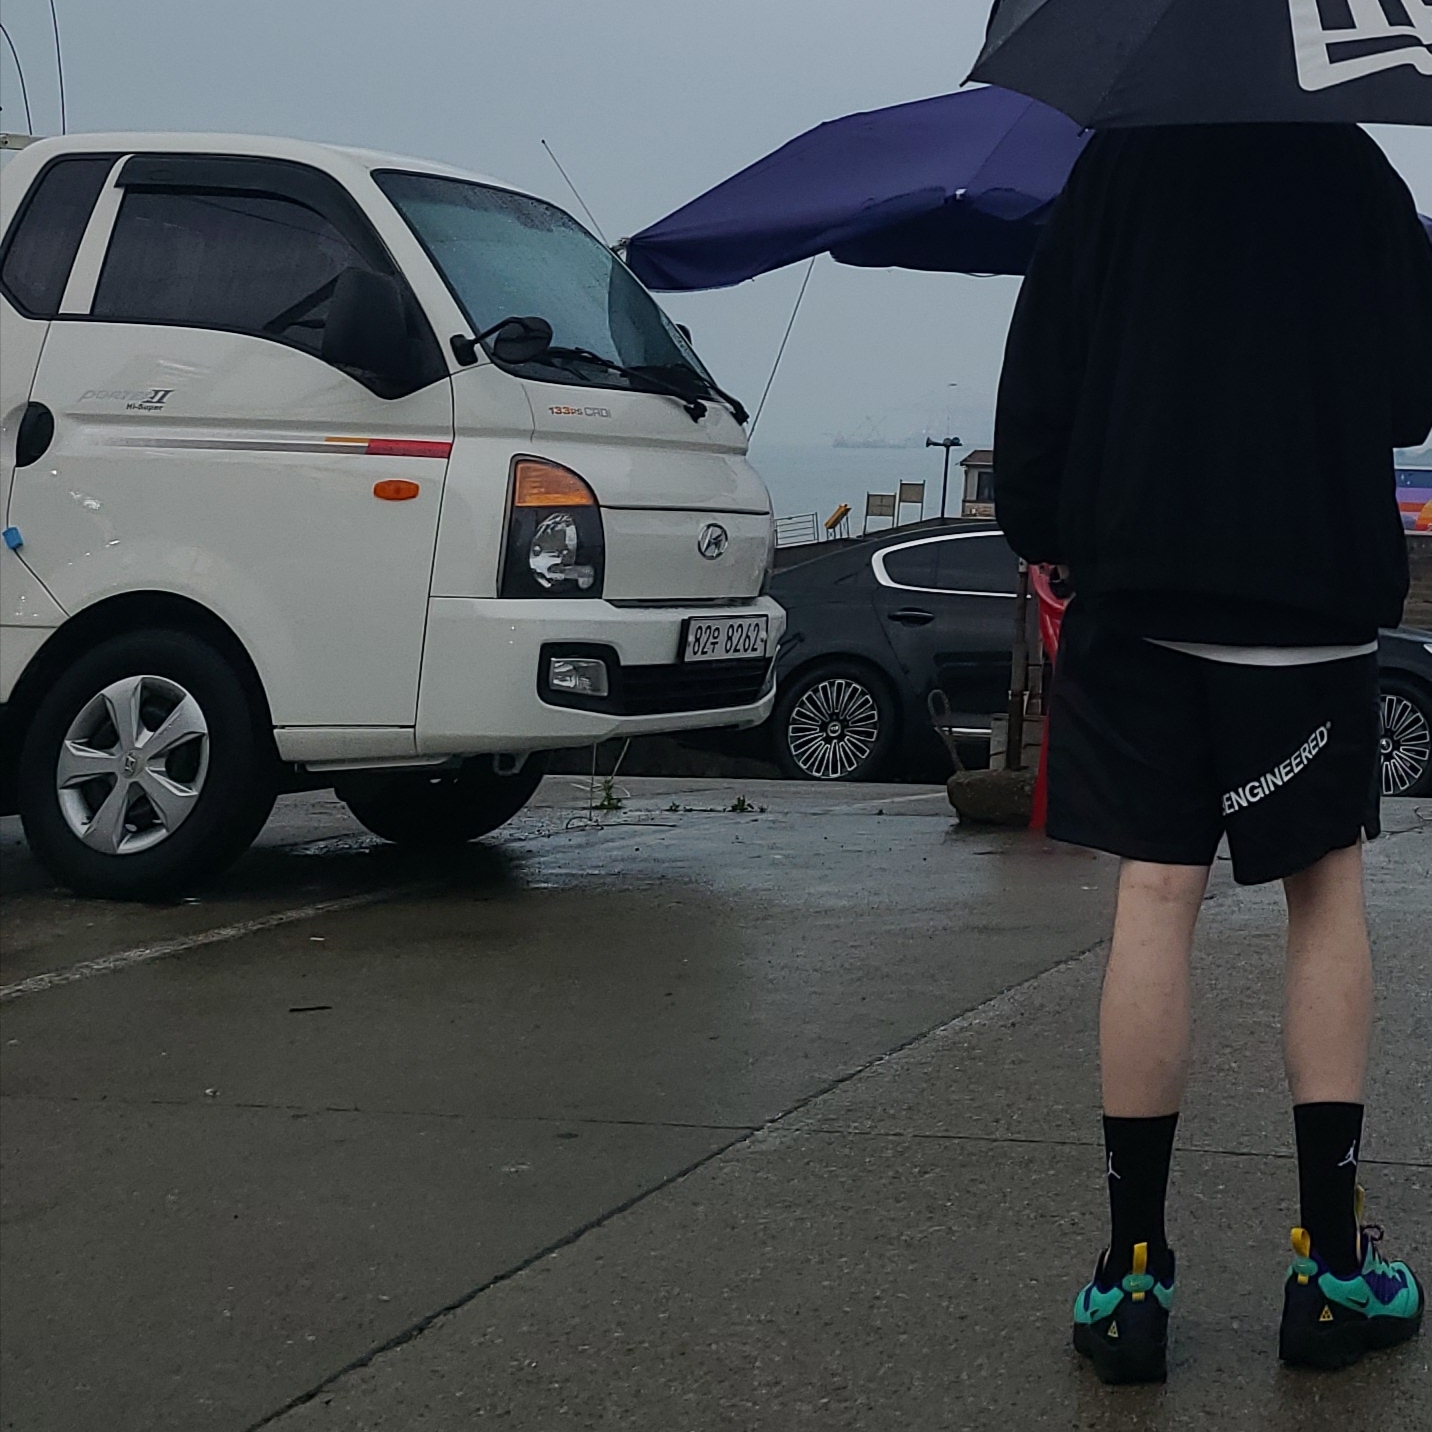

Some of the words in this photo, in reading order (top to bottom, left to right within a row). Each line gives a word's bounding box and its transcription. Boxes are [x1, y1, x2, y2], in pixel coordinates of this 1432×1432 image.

[692, 624, 720, 656] 82우
[724, 622, 760, 654] 8262
[1222, 726, 1328, 816] ENGINEERED
